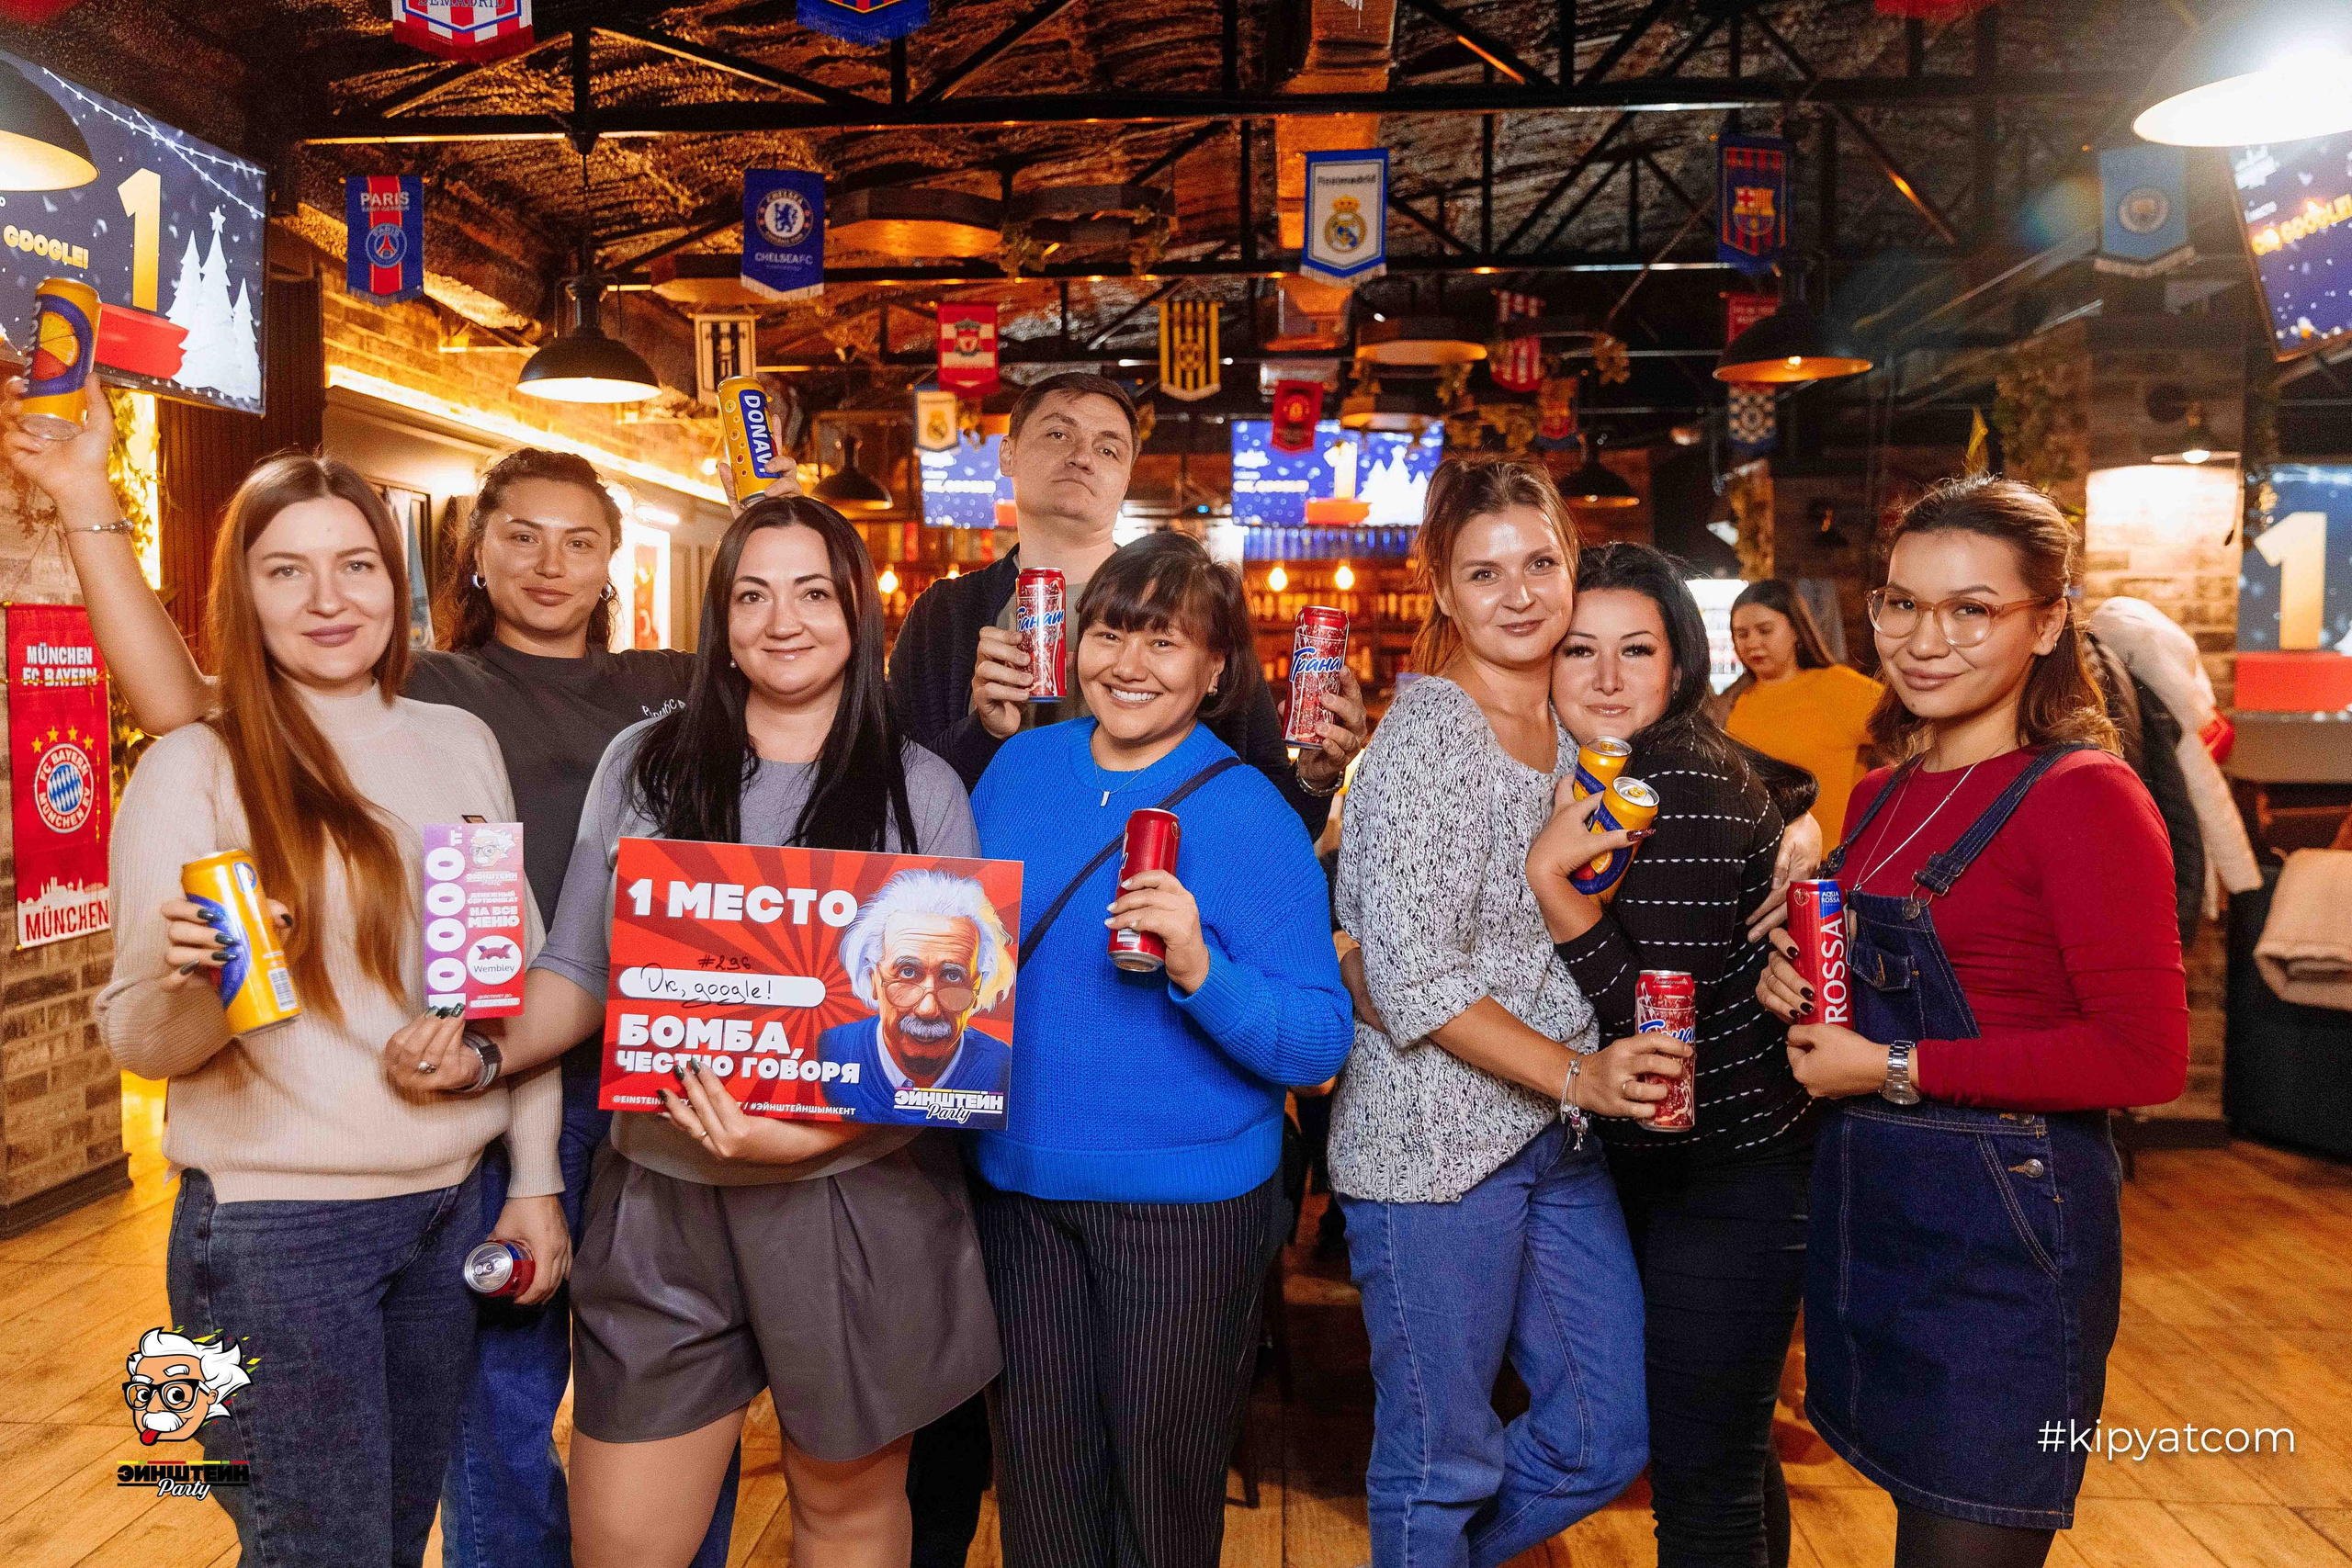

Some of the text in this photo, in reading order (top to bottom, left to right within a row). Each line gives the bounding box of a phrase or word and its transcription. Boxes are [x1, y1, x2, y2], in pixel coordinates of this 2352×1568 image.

[360, 191, 410, 207] PARIS
[3, 224, 90, 270] GOOGLE!
[118, 168, 161, 311] 1
[2254, 512, 2327, 650] 1
[26, 642, 93, 665] MÜNCHEN
[1289, 647, 1344, 682] Грана
[43, 667, 98, 687] BAYERN
[39, 749, 89, 782] FC BAYERN
[469, 905, 518, 917] НА ВСЕ
[628, 878, 858, 928] 1 МЕСТО
[25, 899, 109, 942] MÜNCHEN
[468, 915, 520, 928] МЕНЮ
[473, 964, 515, 974] Wembley
[1820, 918, 1849, 1024] ROSSA
[618, 1013, 805, 1060] БОМБА,
[741, 1056, 861, 1084] ГОВОРЯ
[750, 1102, 856, 1115] #ЭЙНШТЕЙНШЫМКЕНТ
[926, 1102, 972, 1123] Party
